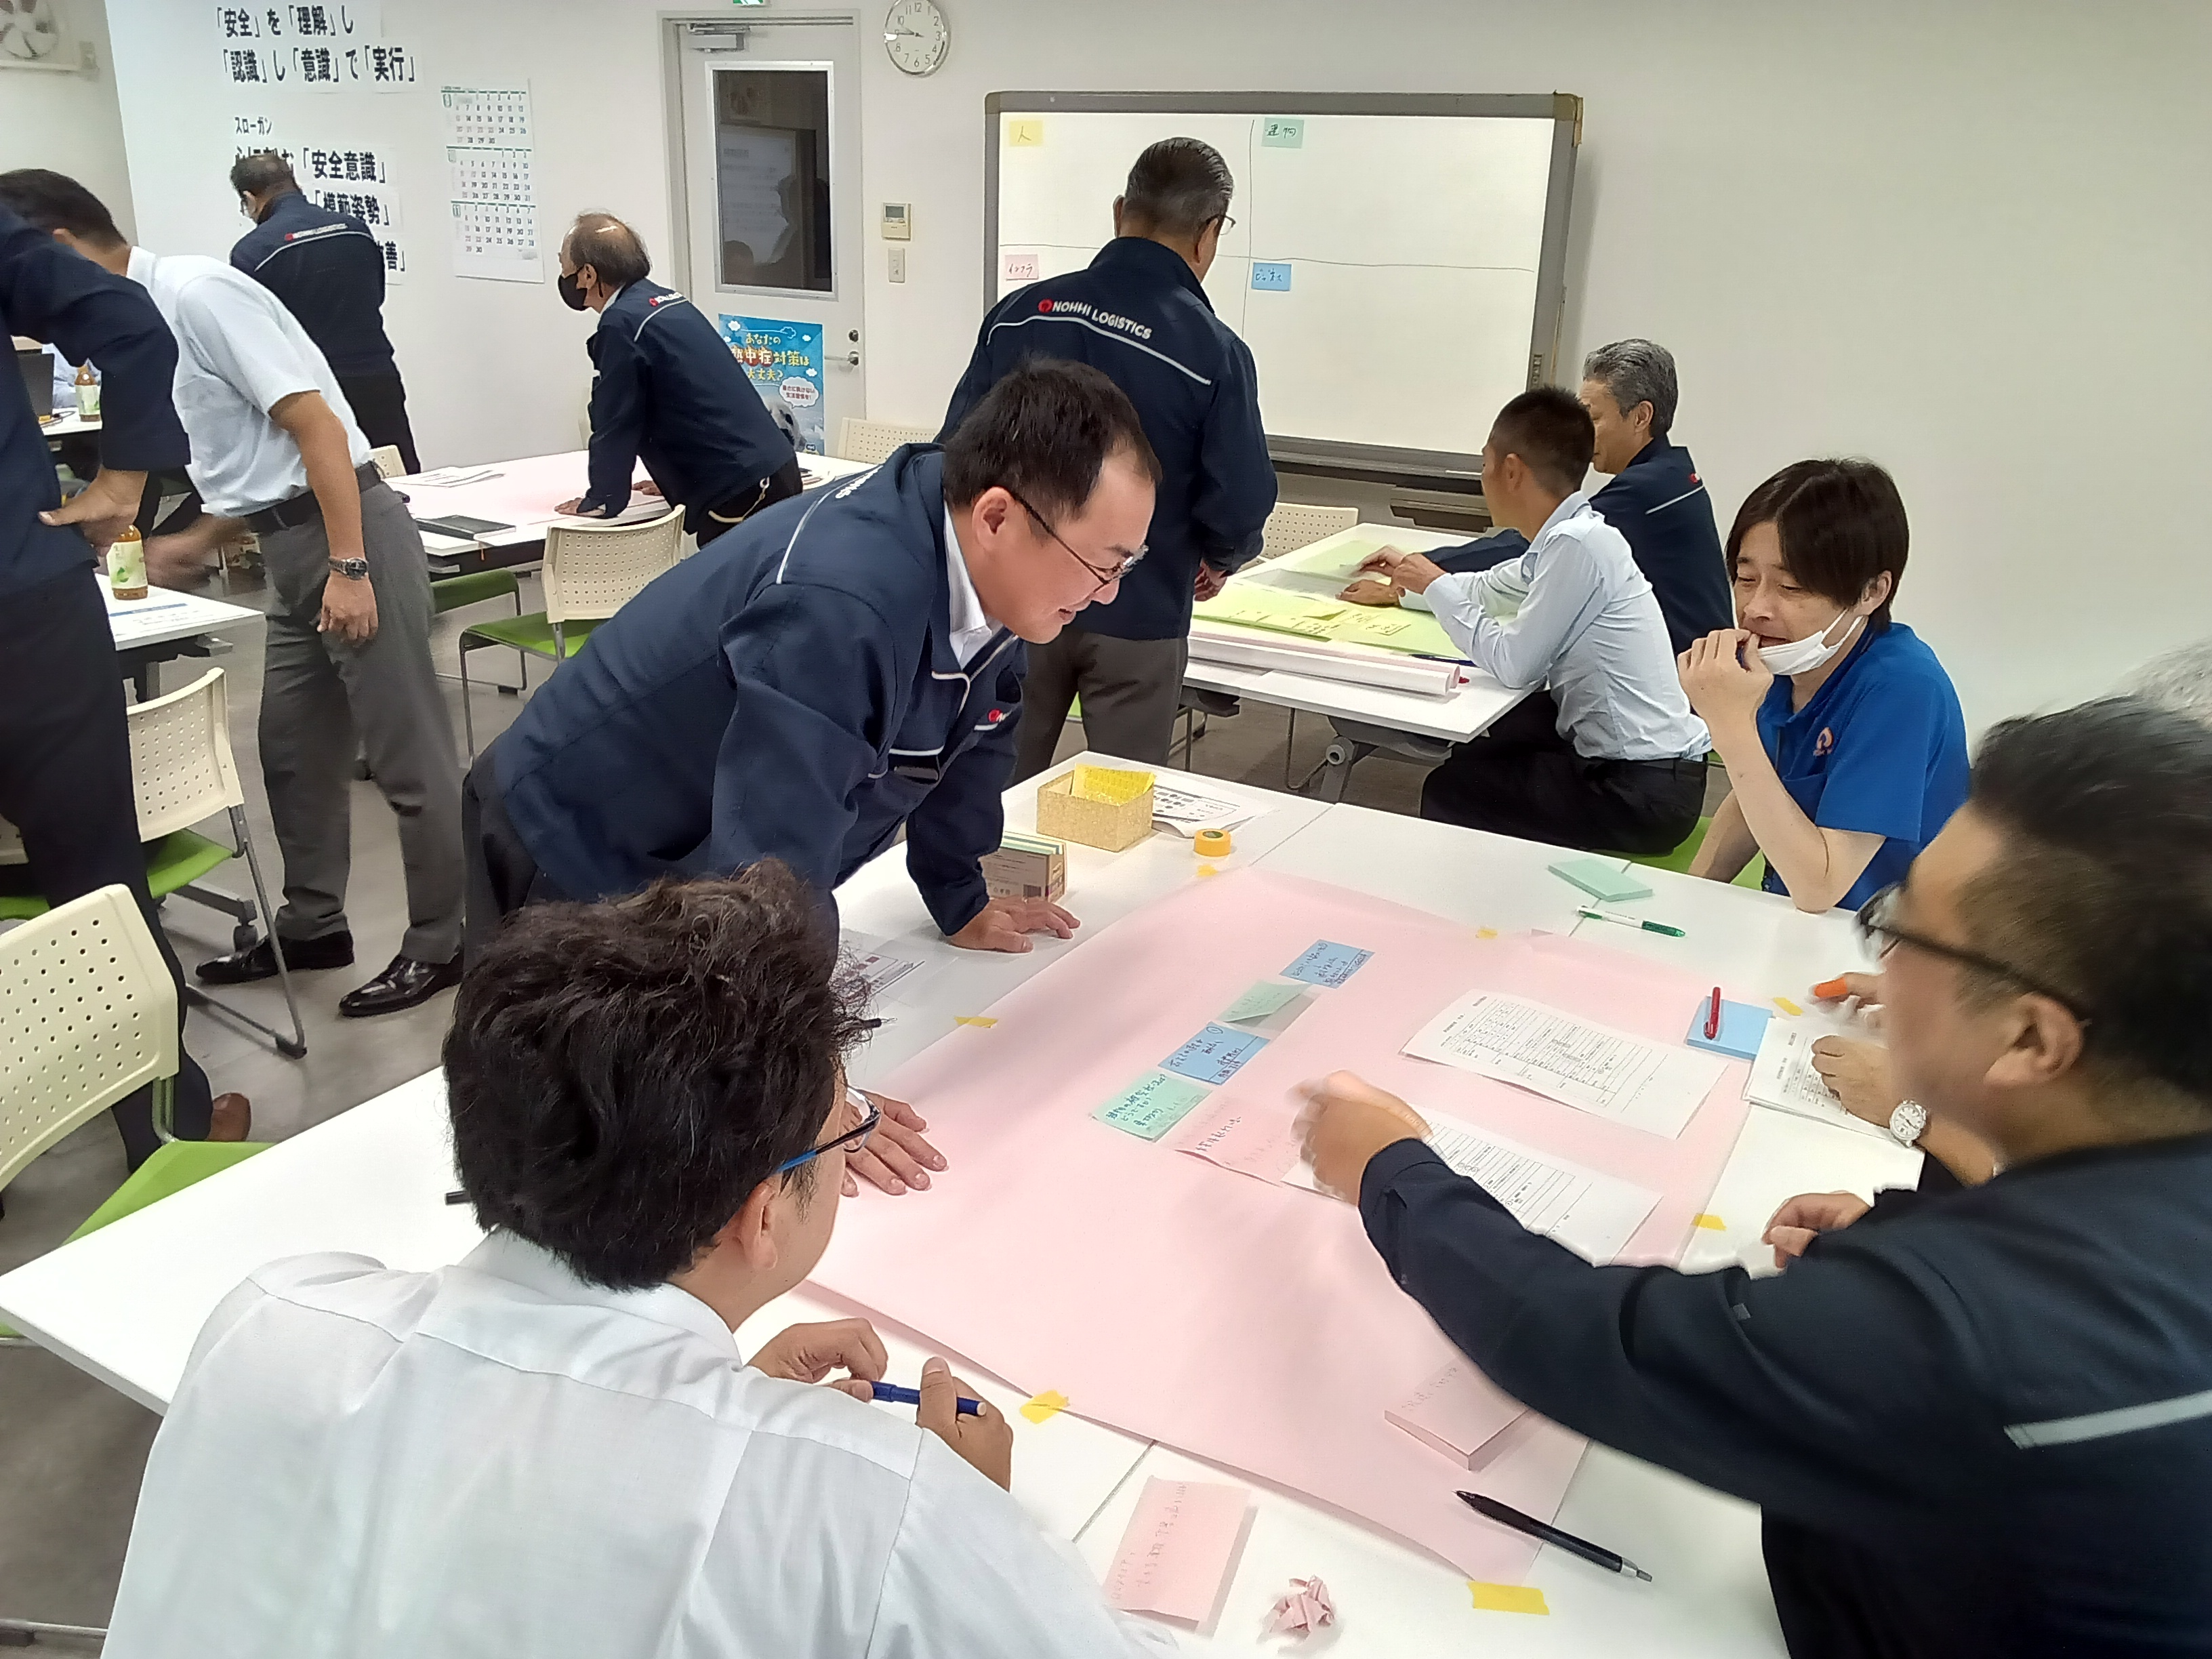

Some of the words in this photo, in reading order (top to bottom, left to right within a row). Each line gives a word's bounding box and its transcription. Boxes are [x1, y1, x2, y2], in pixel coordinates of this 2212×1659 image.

[905, 5, 912, 15] 11
[914, 2, 922, 13] 12
[217, 4, 354, 38] 「安全」を「理解」し
[897, 15, 904, 26] 10
[933, 16, 939, 26] 2
[935, 30, 941, 41] 3
[895, 43, 901, 52] 8
[932, 44, 937, 52] 4
[905, 53, 909, 63] 7
[914, 57, 919, 68] 6
[925, 54, 930, 64] 5
[223, 45, 415, 83] 「認識」し「意識」で「実行」
[234, 117, 272, 136] スローガン
[1017, 125, 1031, 142] 人
[1052, 300, 1092, 316] NOHHI
[1092, 309, 1153, 340] LOGISTICS
[746, 332, 781, 346] あなたの
[747, 368, 783, 382] 大丈夫？
